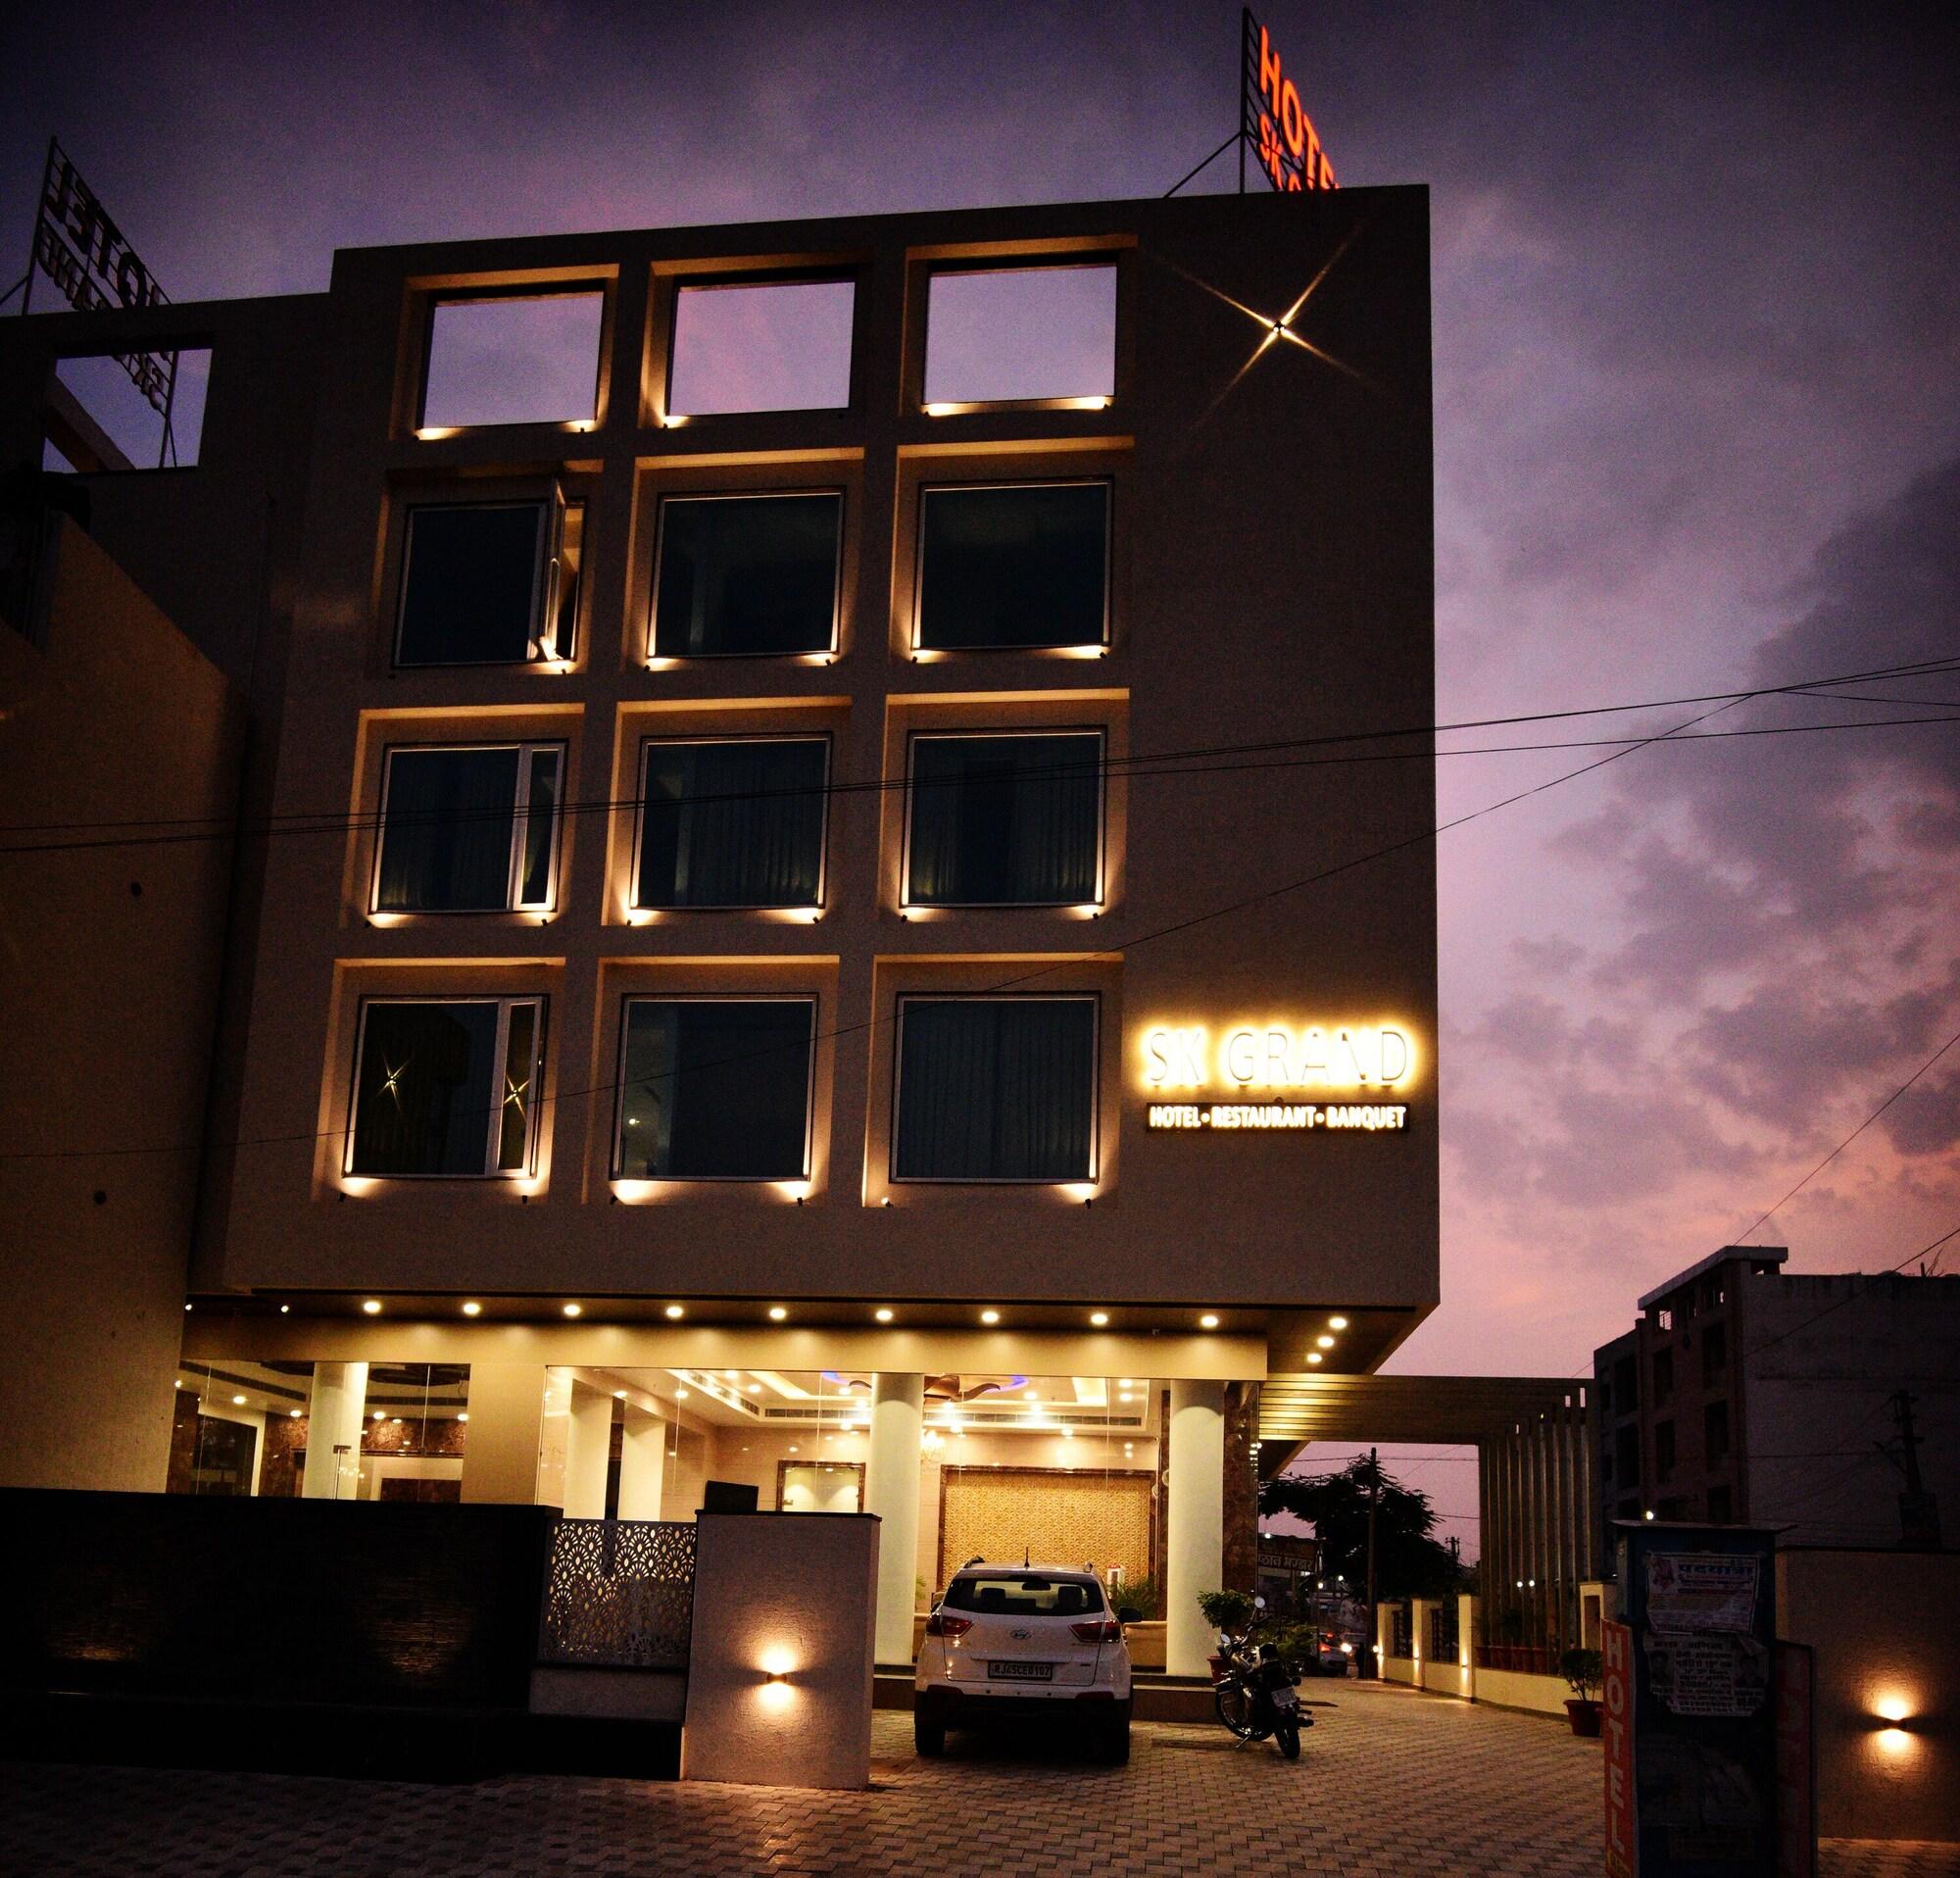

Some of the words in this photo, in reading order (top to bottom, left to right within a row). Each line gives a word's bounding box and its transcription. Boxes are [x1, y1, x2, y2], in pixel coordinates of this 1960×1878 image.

[1259, 25, 1340, 189] HOTE
[1147, 1029, 1202, 1082] SK
[1226, 1029, 1409, 1083] GRAND
[1150, 1107, 1201, 1128] HOTEL
[1210, 1107, 1317, 1128] RESTAURANT
[1326, 1107, 1406, 1131] BANQUET
[1607, 1629, 1625, 1855] HOTEL
